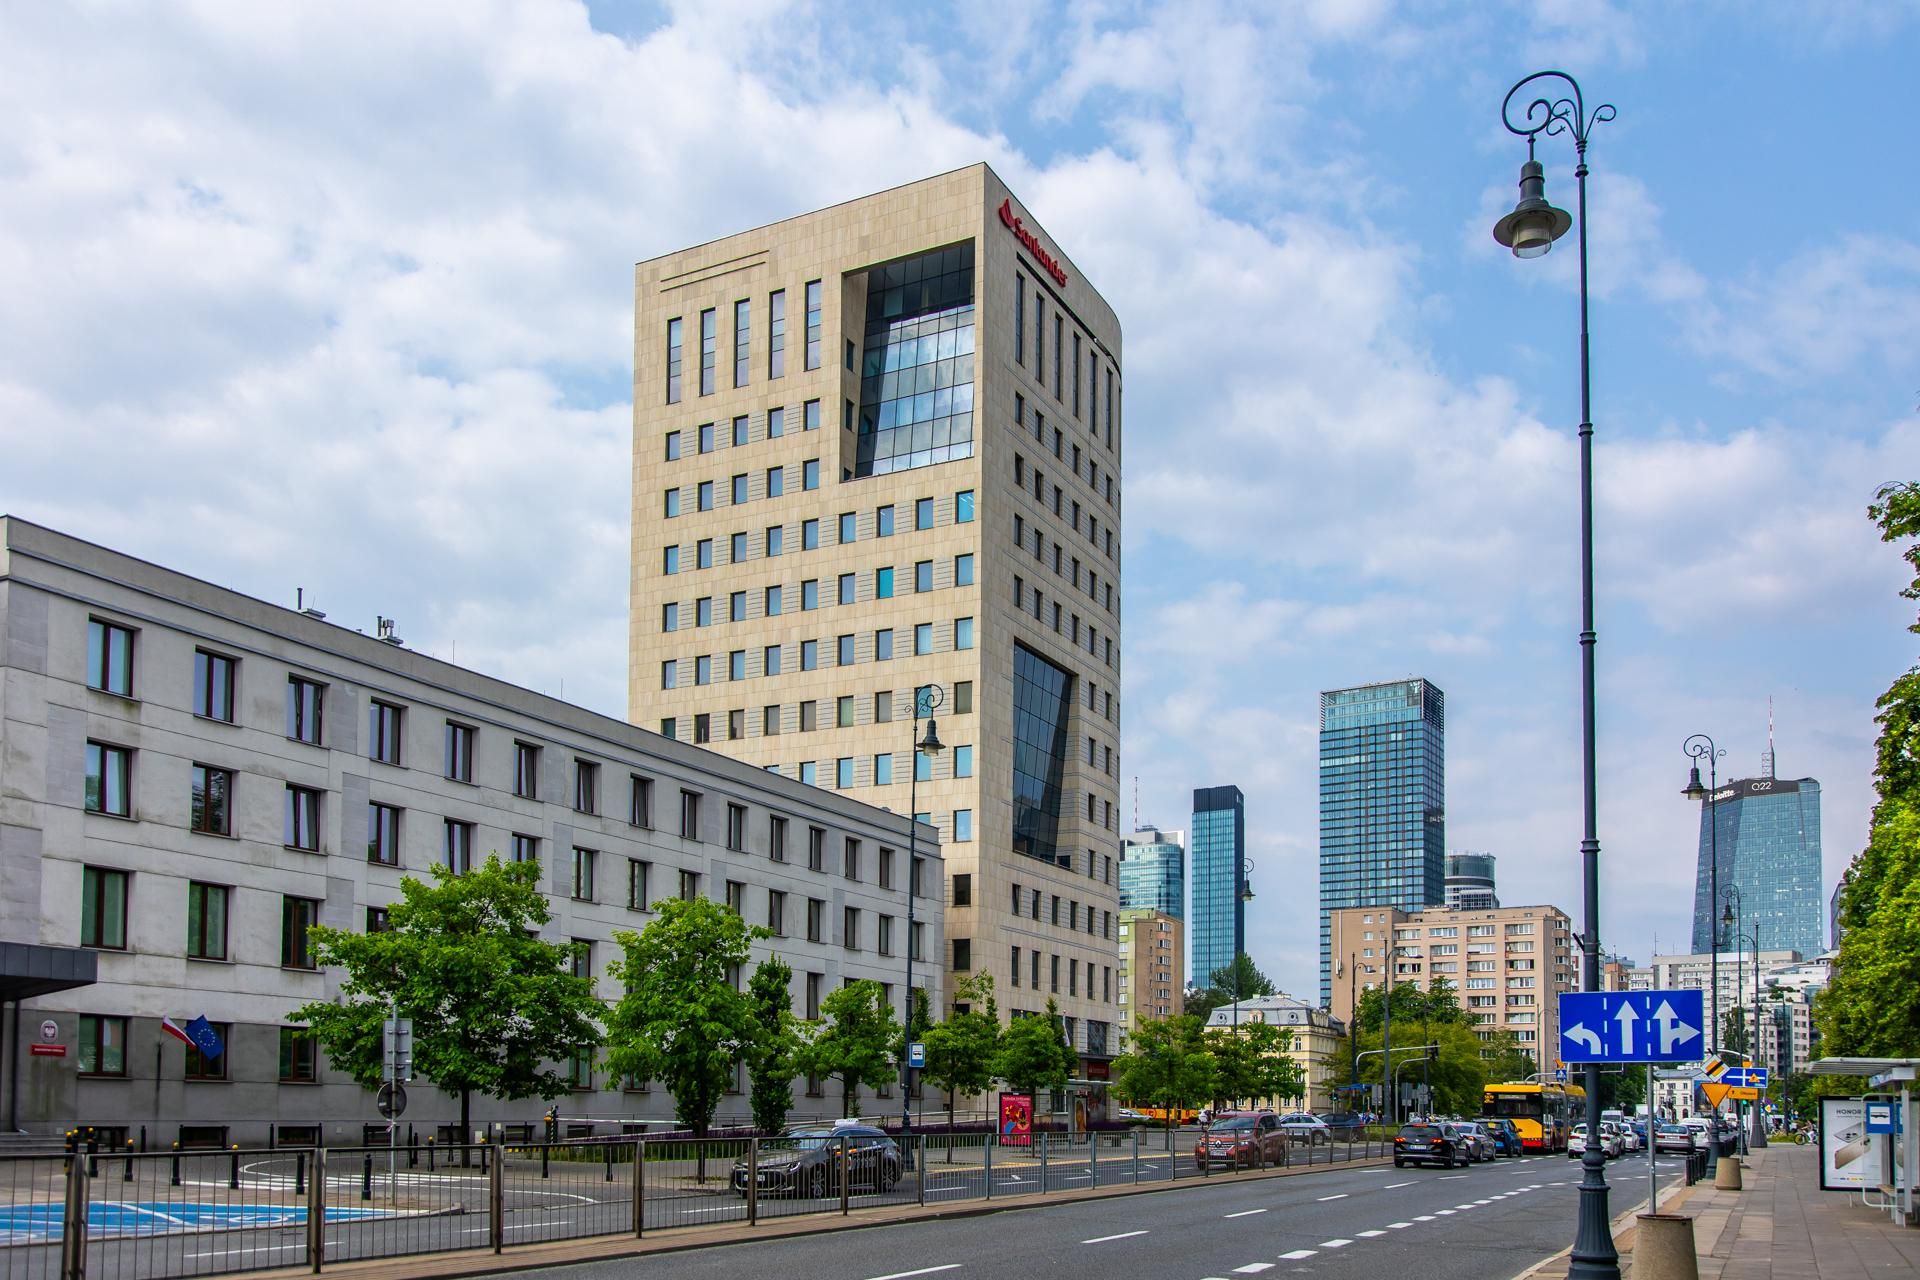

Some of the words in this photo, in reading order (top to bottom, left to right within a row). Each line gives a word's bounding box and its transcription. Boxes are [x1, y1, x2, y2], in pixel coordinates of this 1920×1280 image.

[1014, 215, 1068, 287] Santander
[1751, 781, 1772, 791] Q22
[1708, 789, 1735, 802] Deloitte
